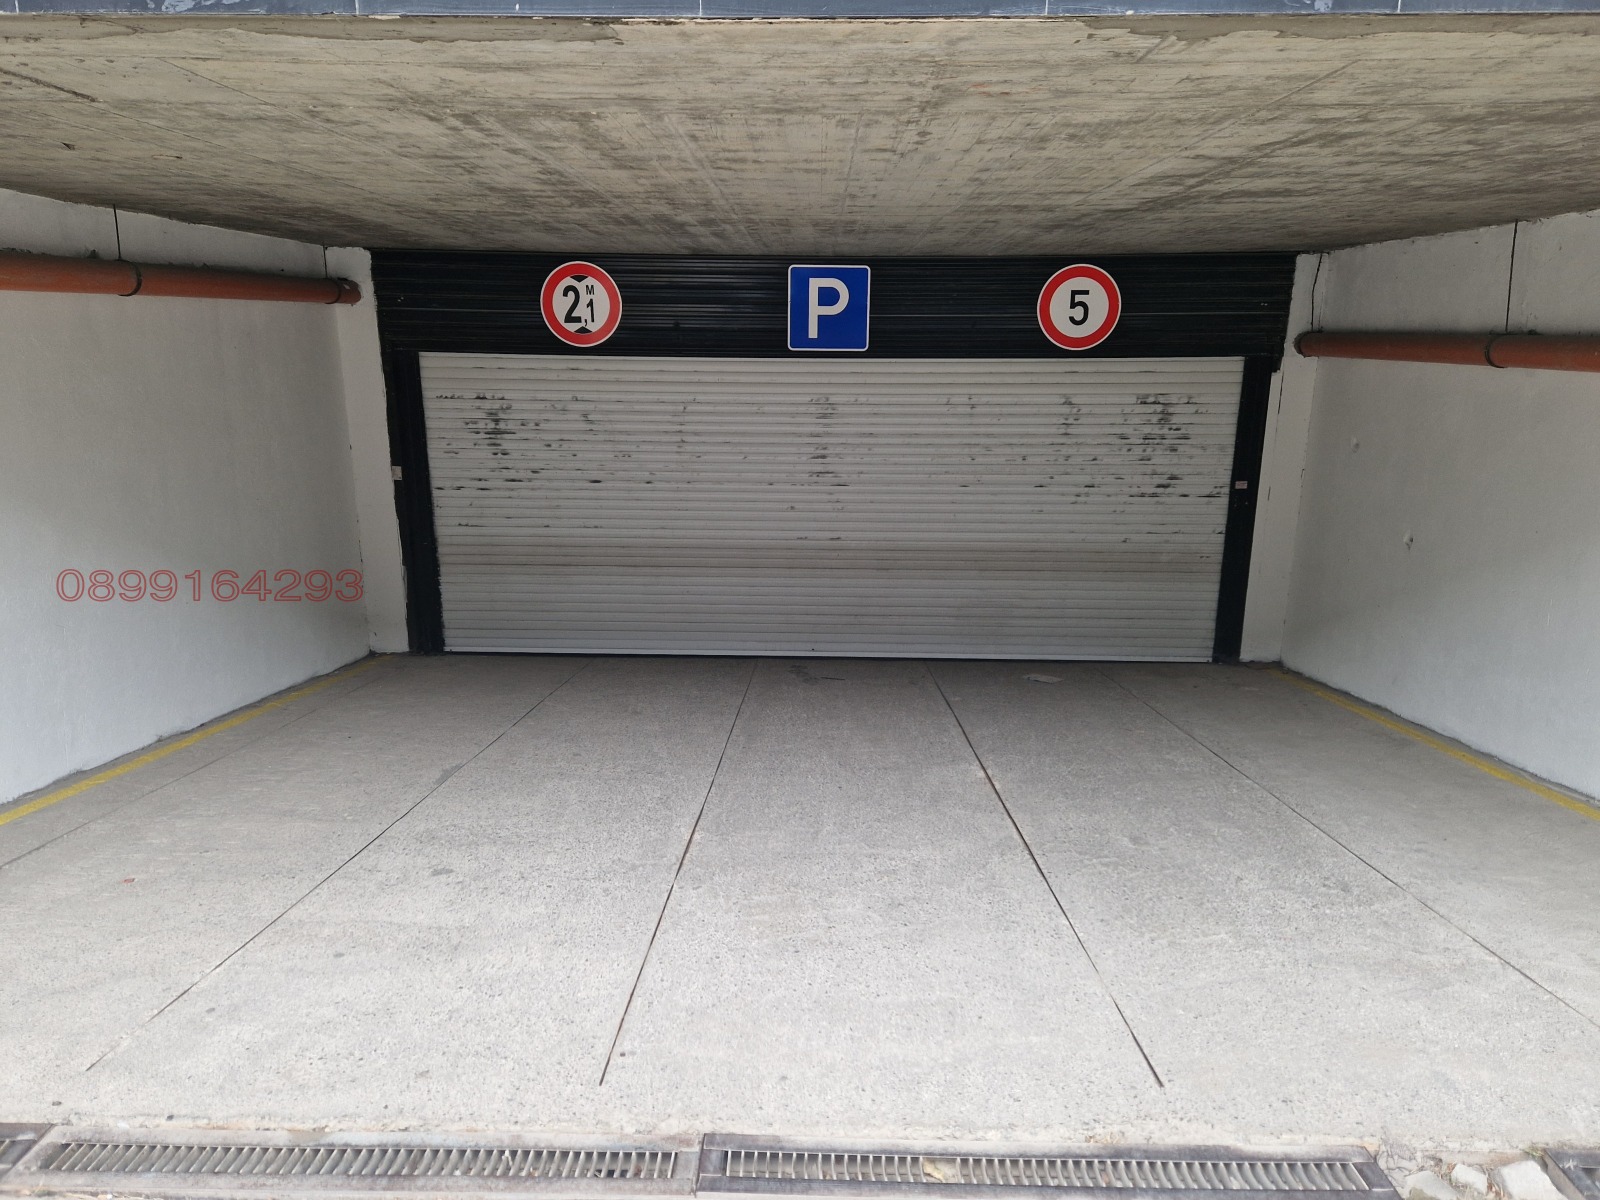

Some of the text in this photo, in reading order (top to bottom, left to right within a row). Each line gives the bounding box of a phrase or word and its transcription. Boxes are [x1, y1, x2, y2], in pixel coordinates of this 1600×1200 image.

[562, 285, 595, 327] 2,1
[808, 277, 850, 339] P
[1068, 289, 1090, 326] 5
